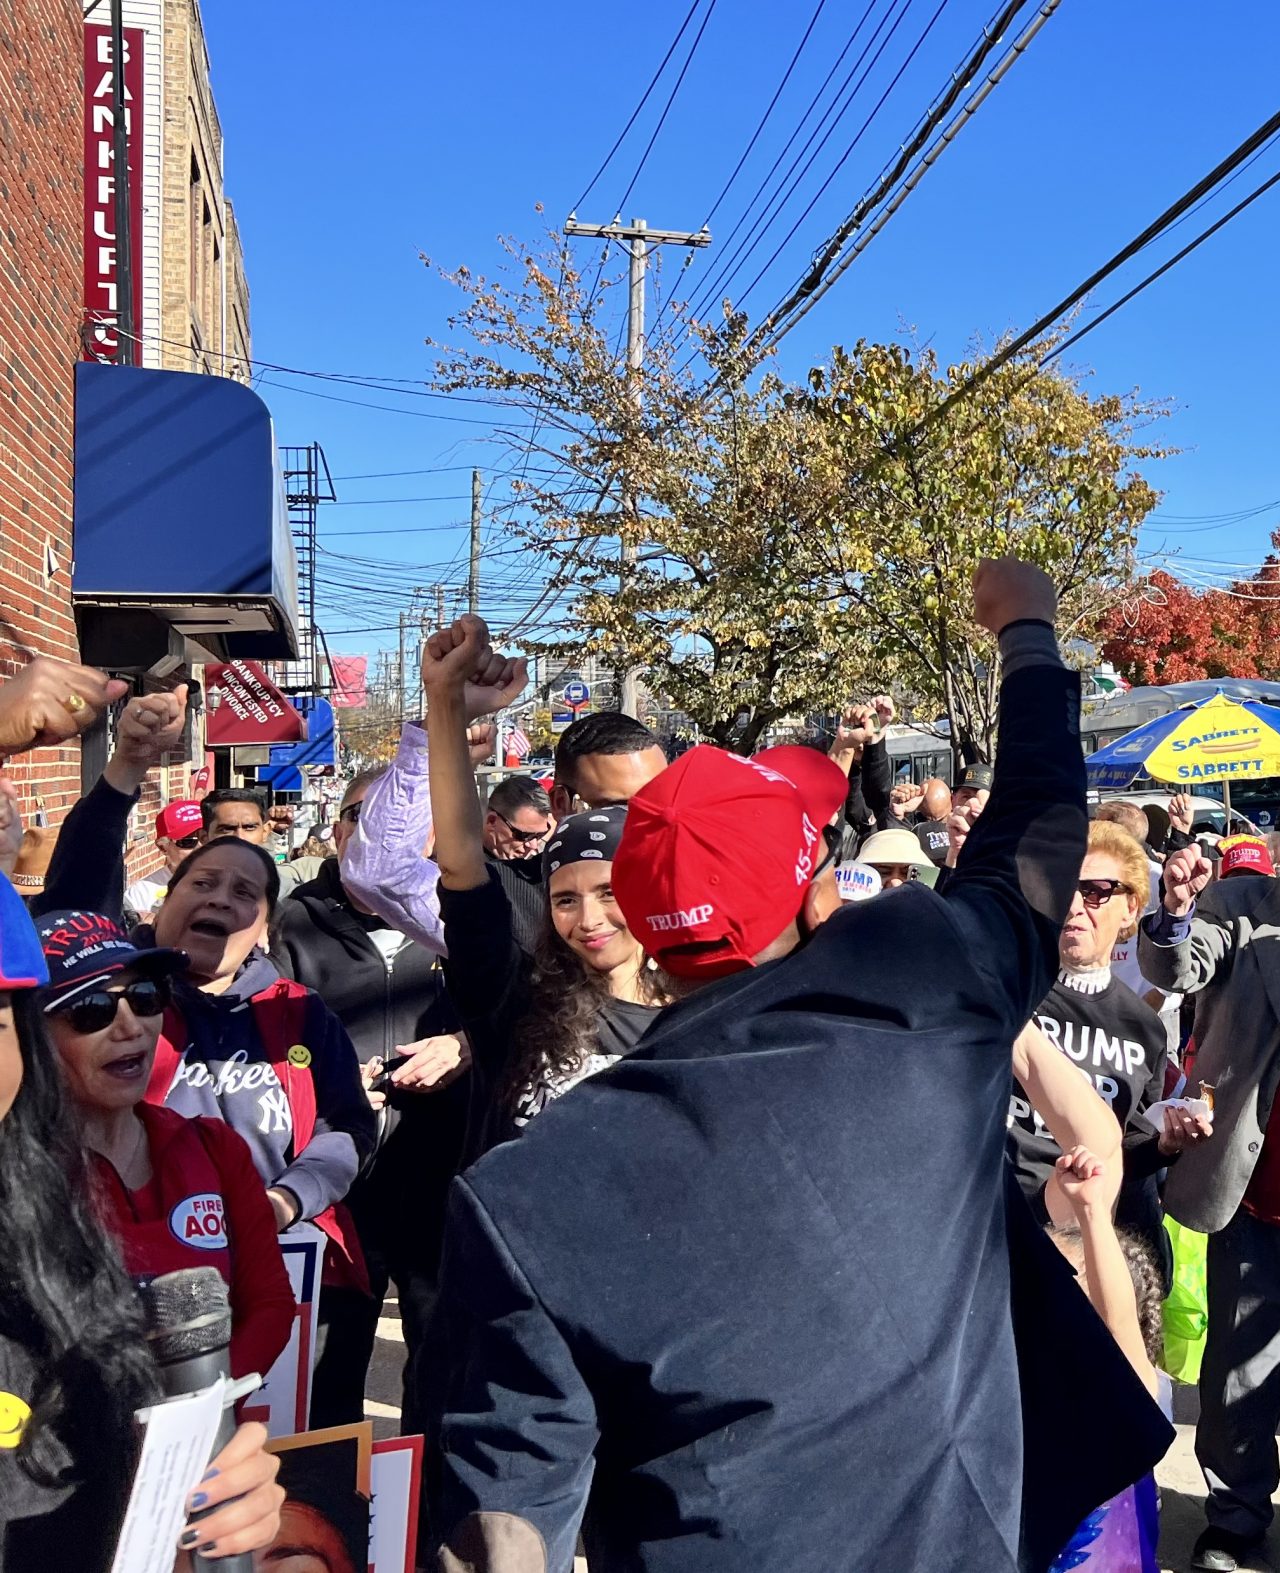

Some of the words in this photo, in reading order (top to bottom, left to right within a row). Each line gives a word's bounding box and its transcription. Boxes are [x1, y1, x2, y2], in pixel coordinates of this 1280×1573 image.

[221, 669, 269, 724] UNCONTESTED
[231, 659, 286, 718] BANKRUPTCY
[220, 686, 250, 721] DIVORCE
[1172, 727, 1260, 752] SABRETT
[1177, 758, 1264, 779] SABRETT
[794, 812, 818, 886] 45-47
[926, 831, 949, 841] Tru
[835, 869, 873, 887] RUMP
[646, 903, 714, 932] TRUMP
[43, 914, 124, 956] TRUM
[76, 944, 103, 959] WILL
[1037, 1014, 1146, 1075] RUMP
[193, 1200, 222, 1213] FIRE
[185, 1213, 227, 1238] AO
